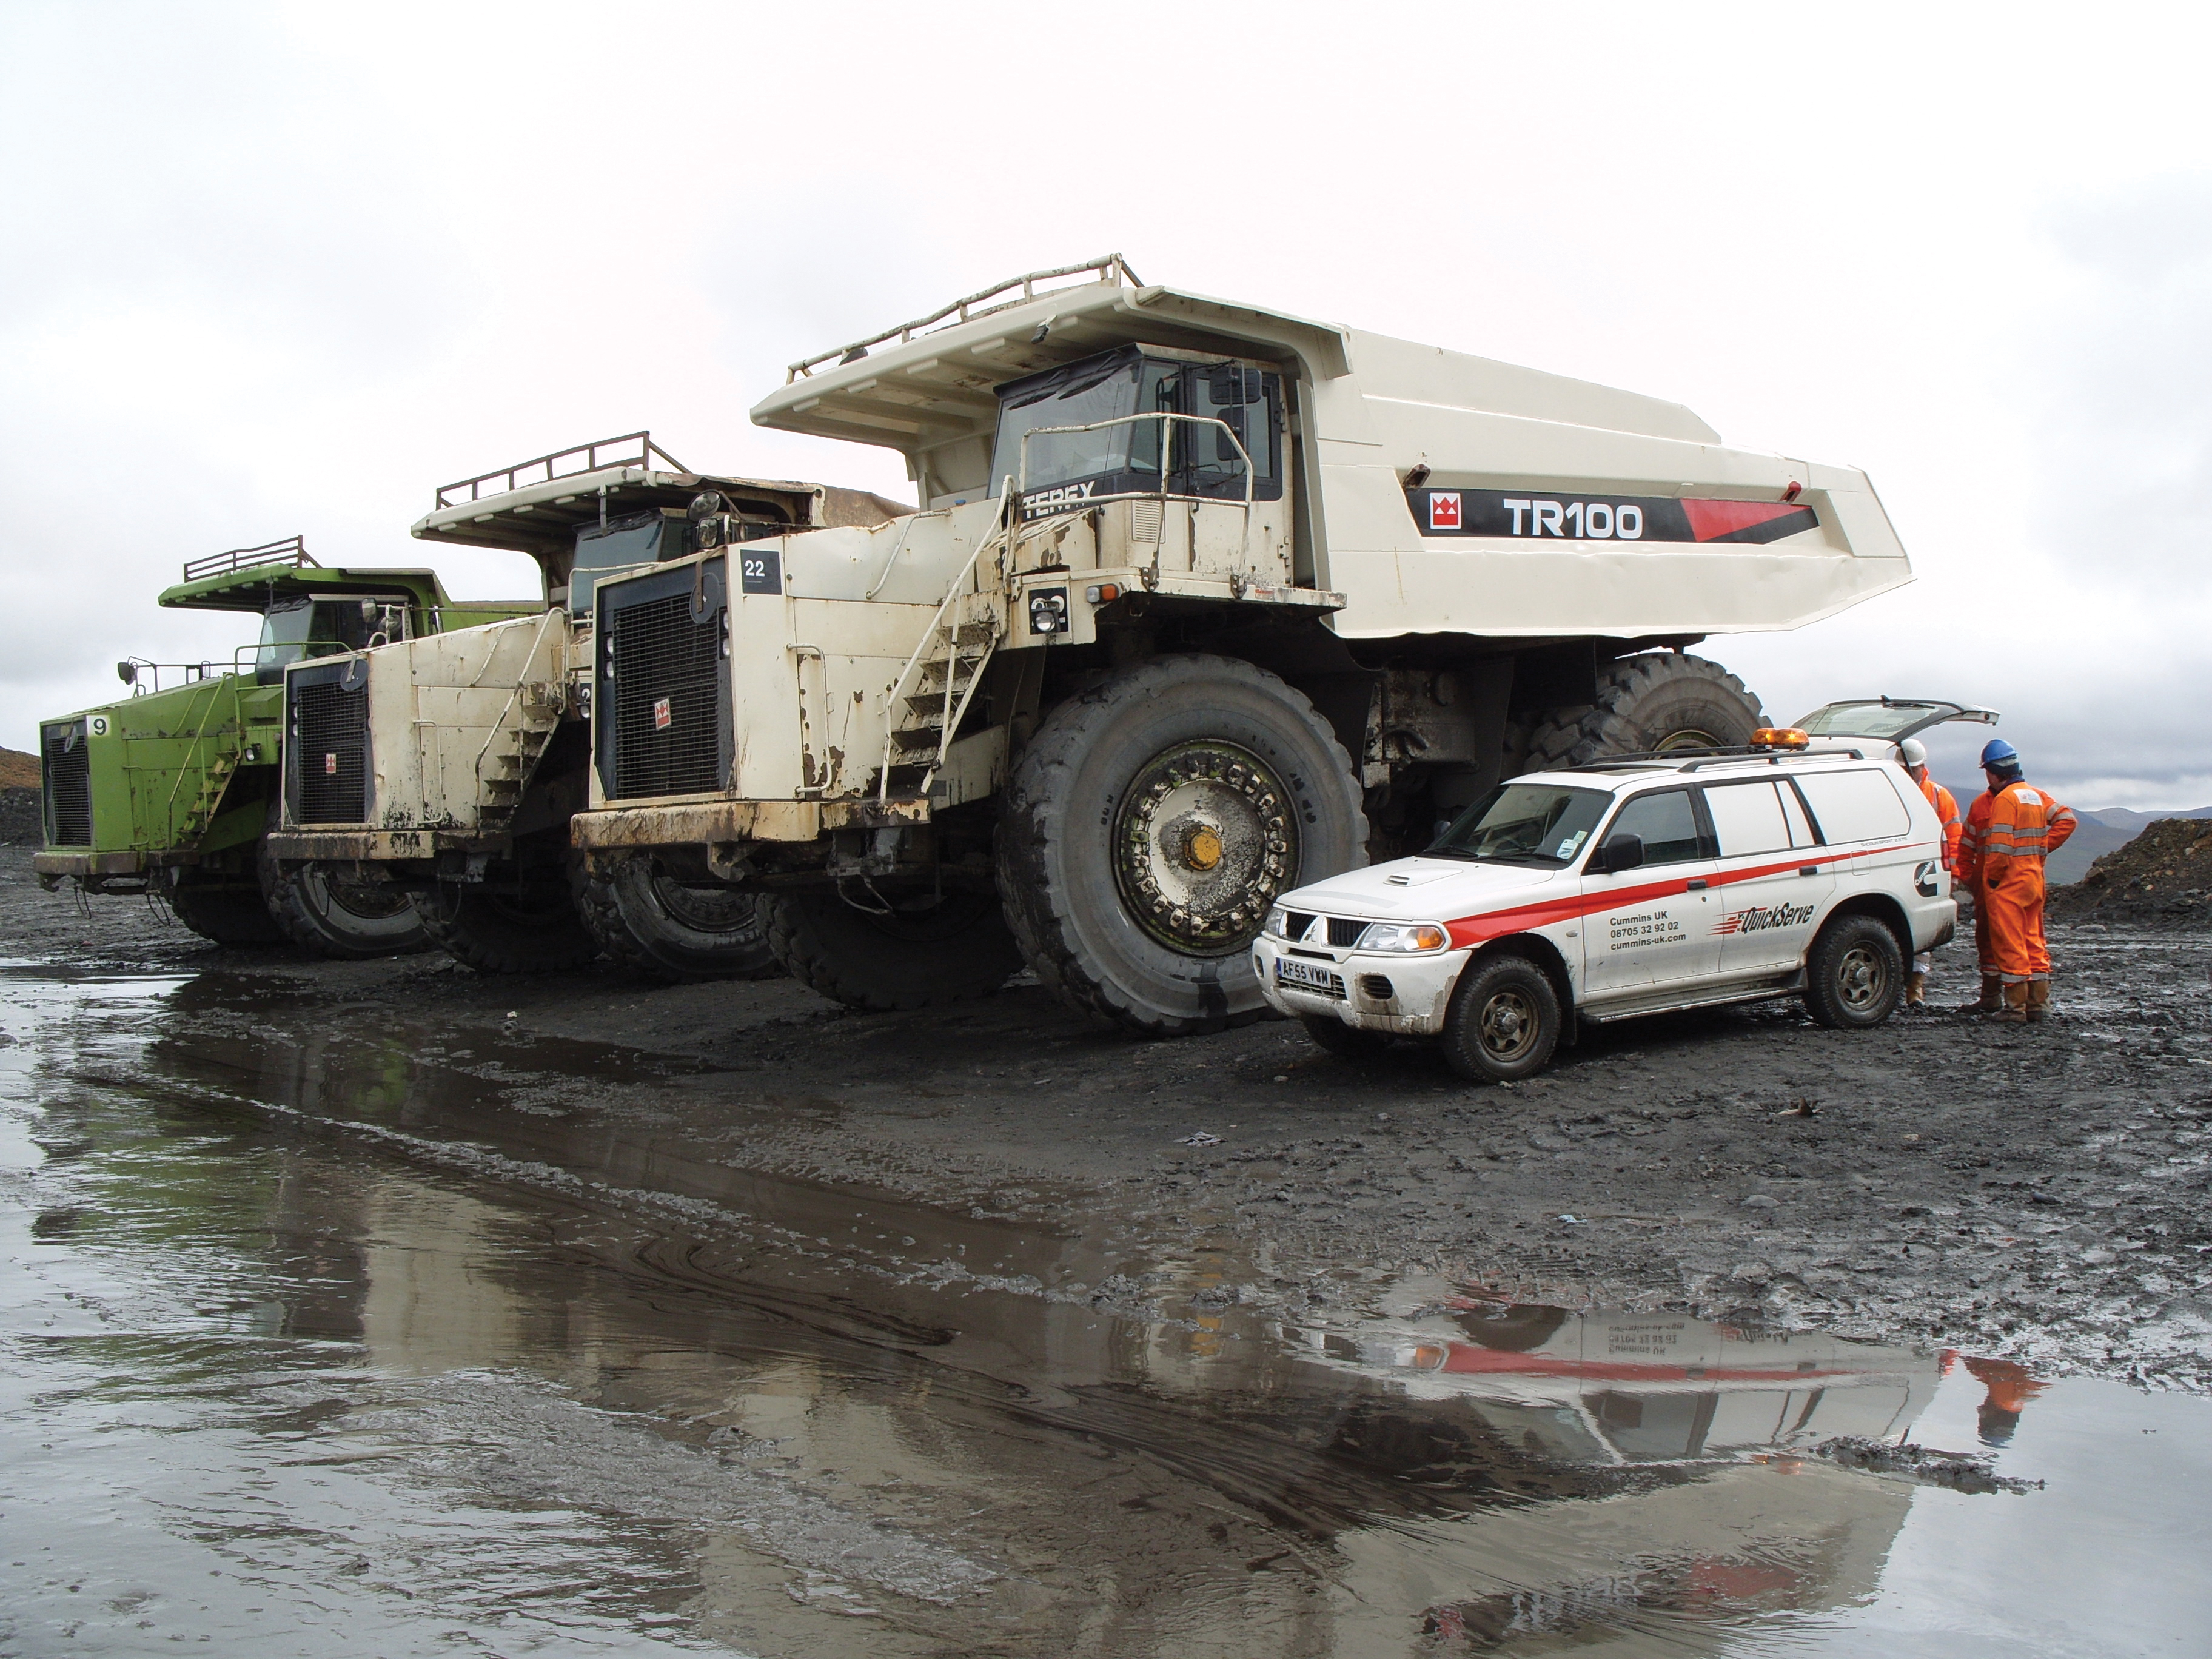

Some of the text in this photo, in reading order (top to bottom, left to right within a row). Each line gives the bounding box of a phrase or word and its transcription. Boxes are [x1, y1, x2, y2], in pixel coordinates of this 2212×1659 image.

[1022, 480, 1095, 519] TEREX
[1503, 498, 1643, 539] TR100
[745, 560, 765, 577] 22
[93, 718, 107, 736] 9
[1914, 860, 1934, 886] Cummins
[1610, 911, 1668, 926] Cummins UK
[1740, 902, 1814, 934] QuickServe
[1610, 922, 1678, 939] 08705 32 92 02
[1610, 934, 1686, 950] cummins-uk.com
[1283, 962, 1329, 985] AF55 VWM
